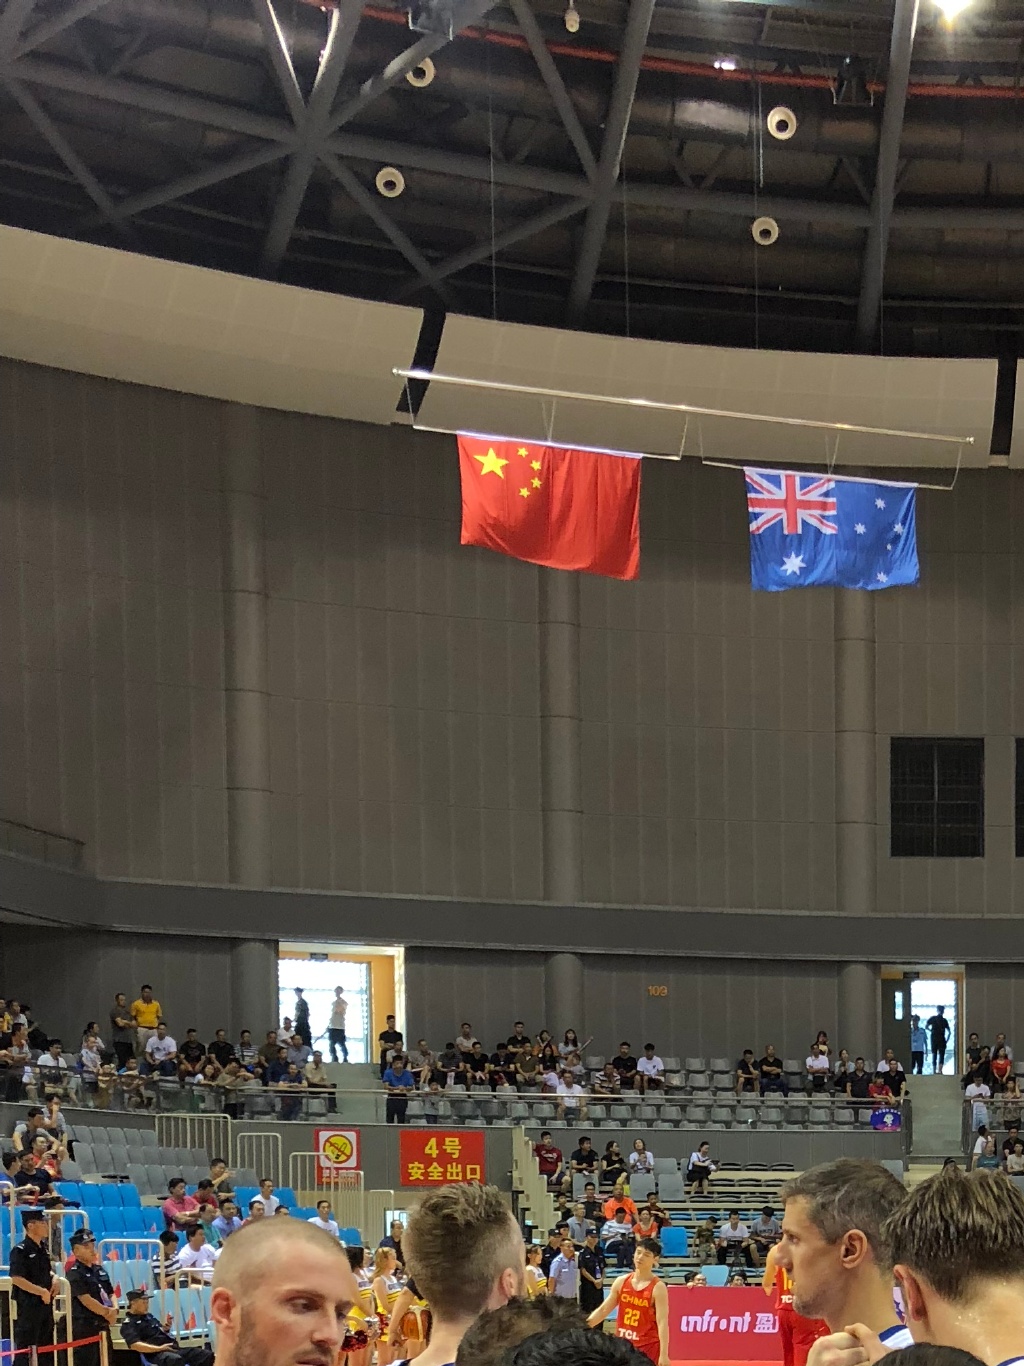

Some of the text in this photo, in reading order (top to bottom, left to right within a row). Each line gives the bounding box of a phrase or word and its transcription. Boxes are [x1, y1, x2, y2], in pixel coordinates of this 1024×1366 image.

[424, 1137, 462, 1158] 4号
[408, 1162, 481, 1181] 安全出口
[621, 1293, 649, 1308] CHINA
[623, 1308, 641, 1327] 22
[618, 1327, 640, 1341] TCL
